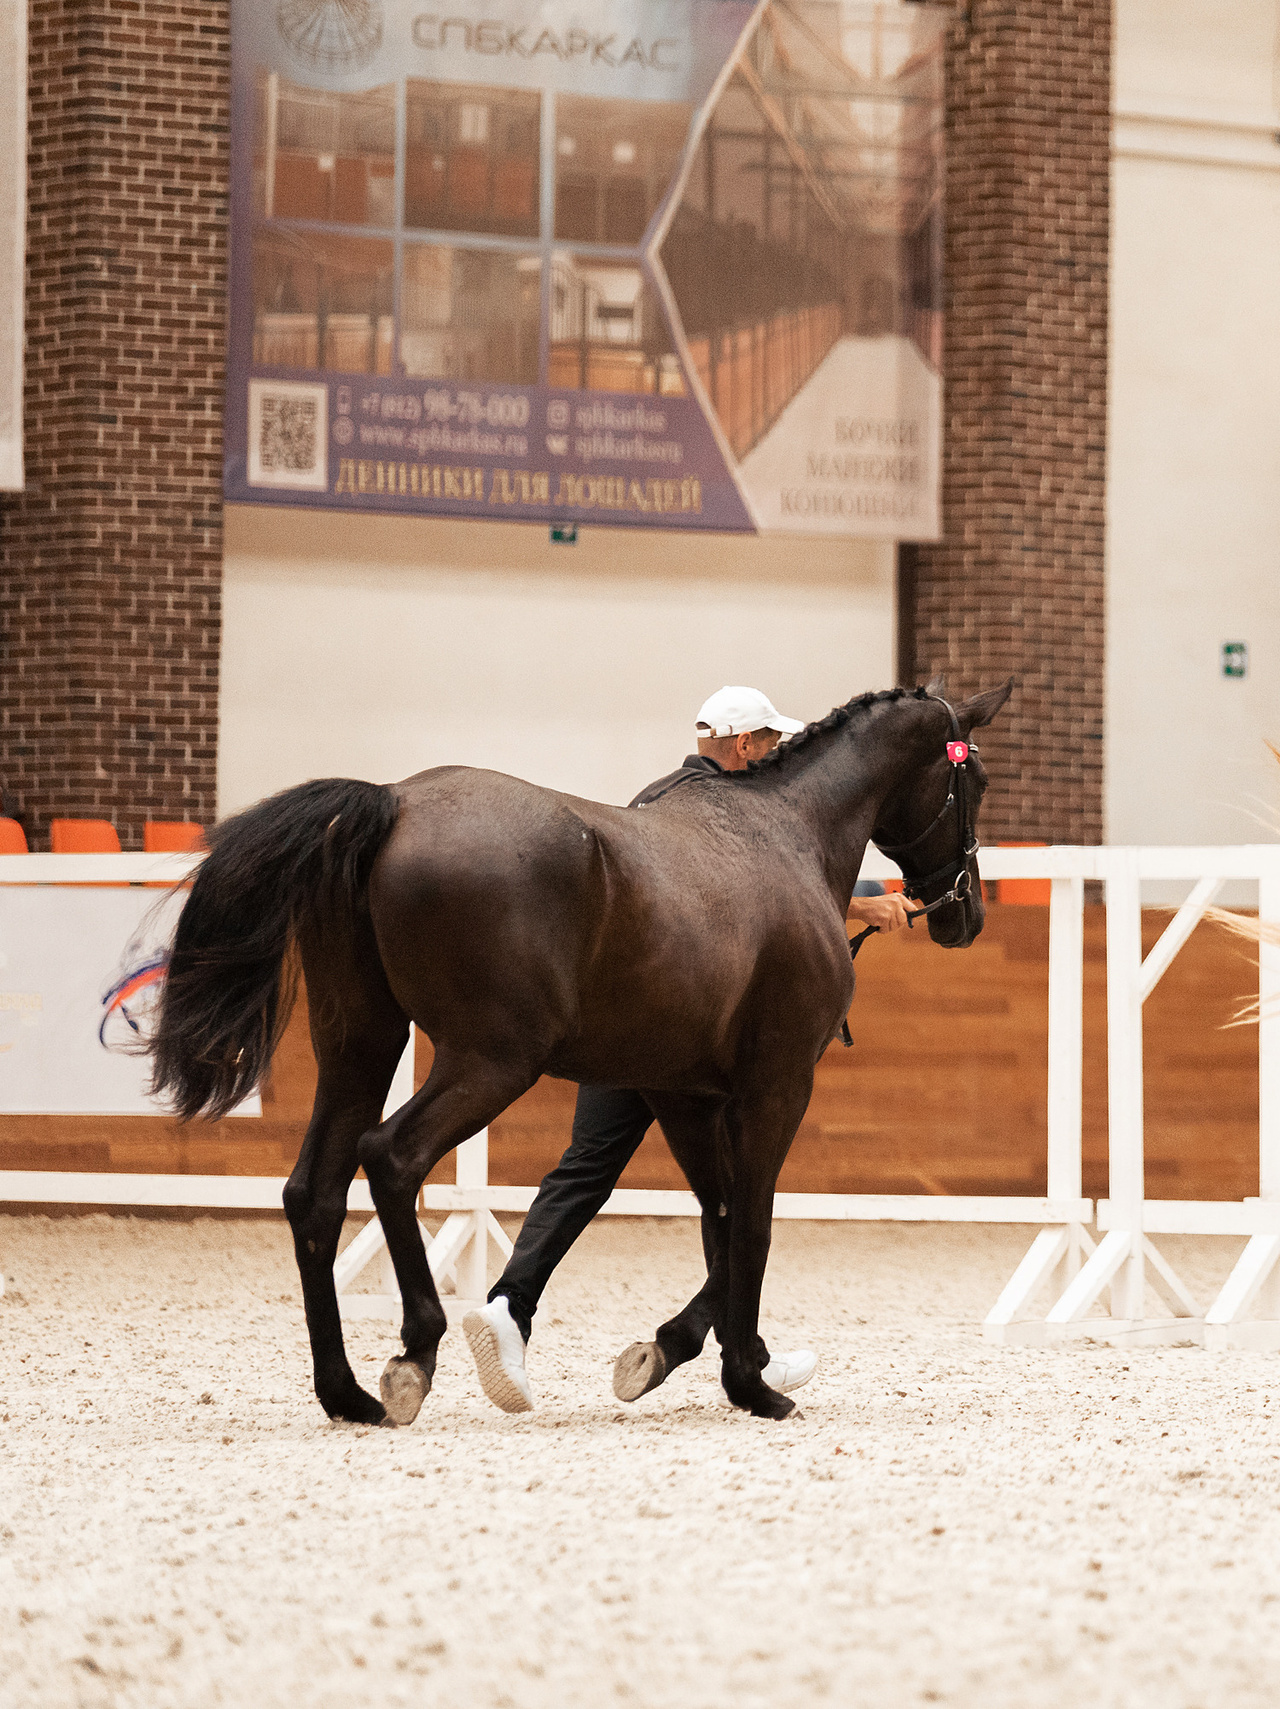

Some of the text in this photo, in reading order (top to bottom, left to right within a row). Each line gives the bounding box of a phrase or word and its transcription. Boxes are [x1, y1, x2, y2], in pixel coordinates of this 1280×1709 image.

[411, 14, 678, 72] СПБКАРКАС
[335, 458, 702, 514] ДЕННИКИ ДЛЯ ЛОШАДЕЙ
[955, 746, 963, 757] 6
